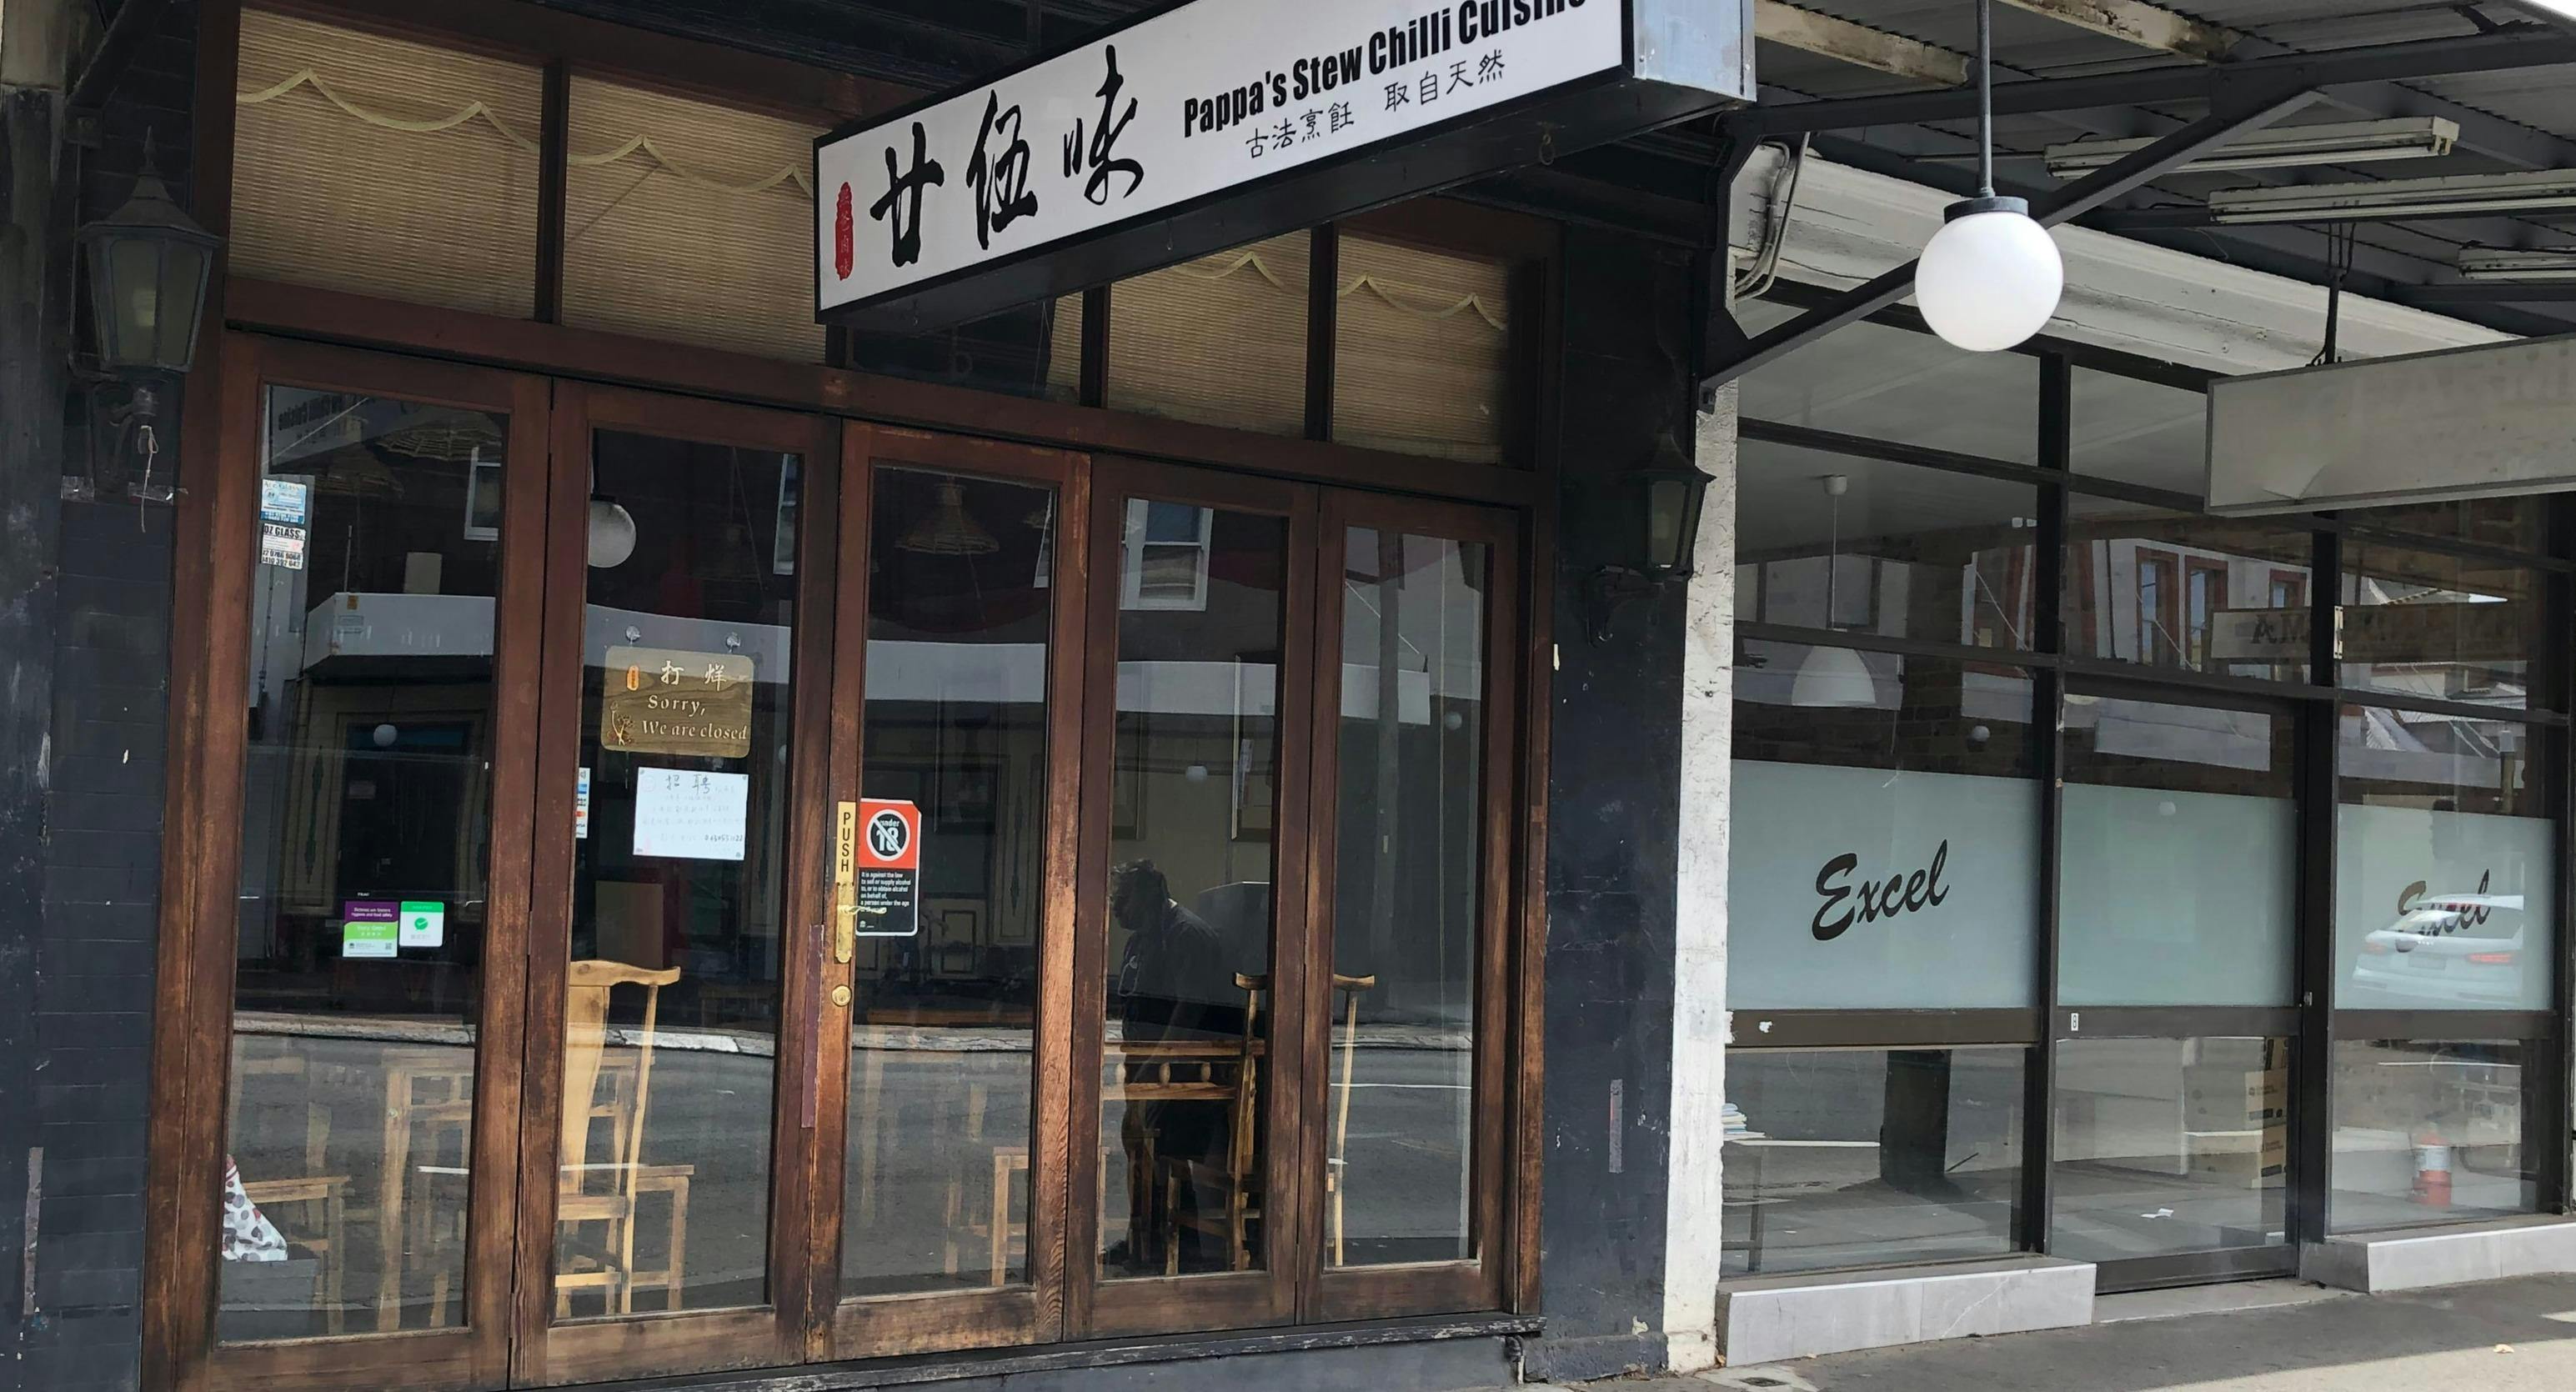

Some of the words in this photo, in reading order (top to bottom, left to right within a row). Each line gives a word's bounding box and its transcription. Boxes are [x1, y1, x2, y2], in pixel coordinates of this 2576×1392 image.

[1185, 71, 1287, 138] Pappa's
[1293, 46, 1362, 101] Stew
[1369, 8, 1451, 76] Chilli
[1384, 48, 1506, 113] 取自天然
[275, 527, 301, 538] GLASS
[660, 660, 727, 691] 打烊
[648, 694, 706, 718] Sorry,
[642, 720, 667, 735] We
[671, 723, 695, 738] are
[700, 722, 747, 740] closed
[841, 812, 851, 872] PUSH
[876, 827, 900, 852] 18
[1812, 839, 1949, 941] Excel
